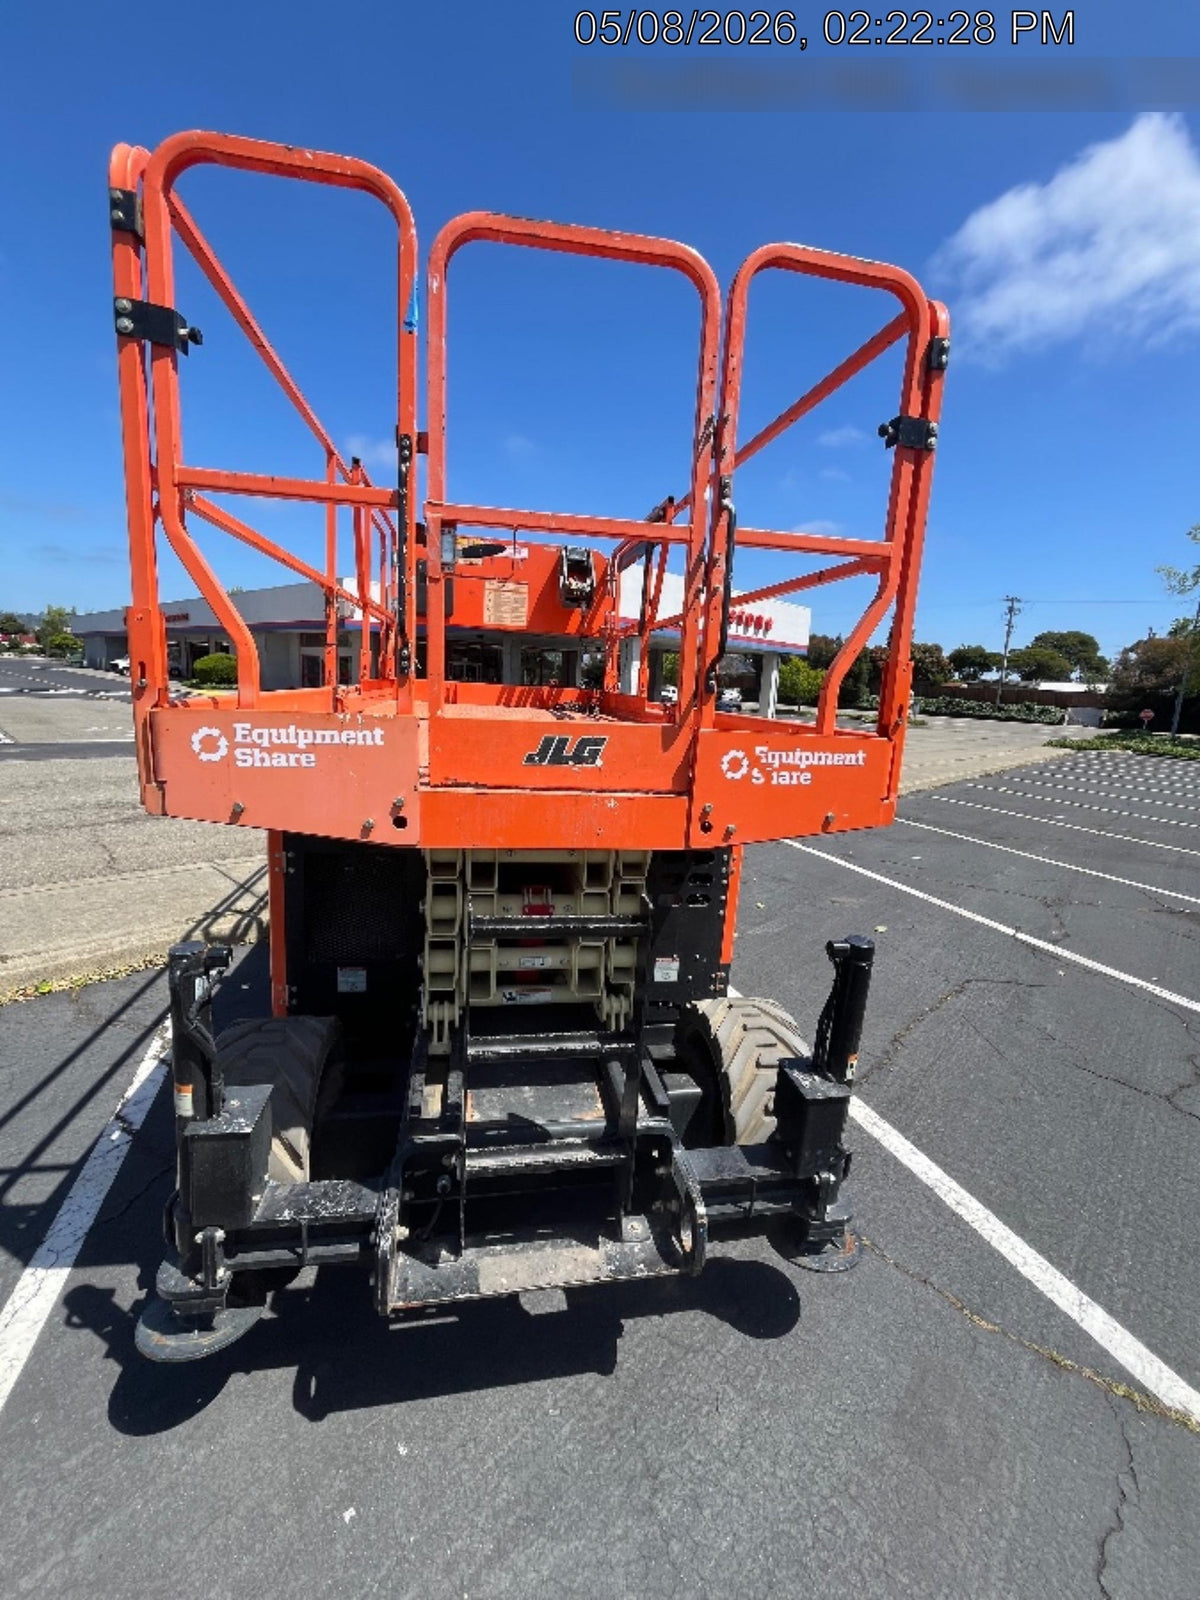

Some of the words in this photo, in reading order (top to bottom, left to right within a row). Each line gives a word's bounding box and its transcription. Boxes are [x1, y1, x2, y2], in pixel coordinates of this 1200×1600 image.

[233, 722, 384, 749] Equipment
[234, 747, 317, 768] Share
[522, 734, 609, 767] JLG
[755, 746, 866, 769] Equipment
